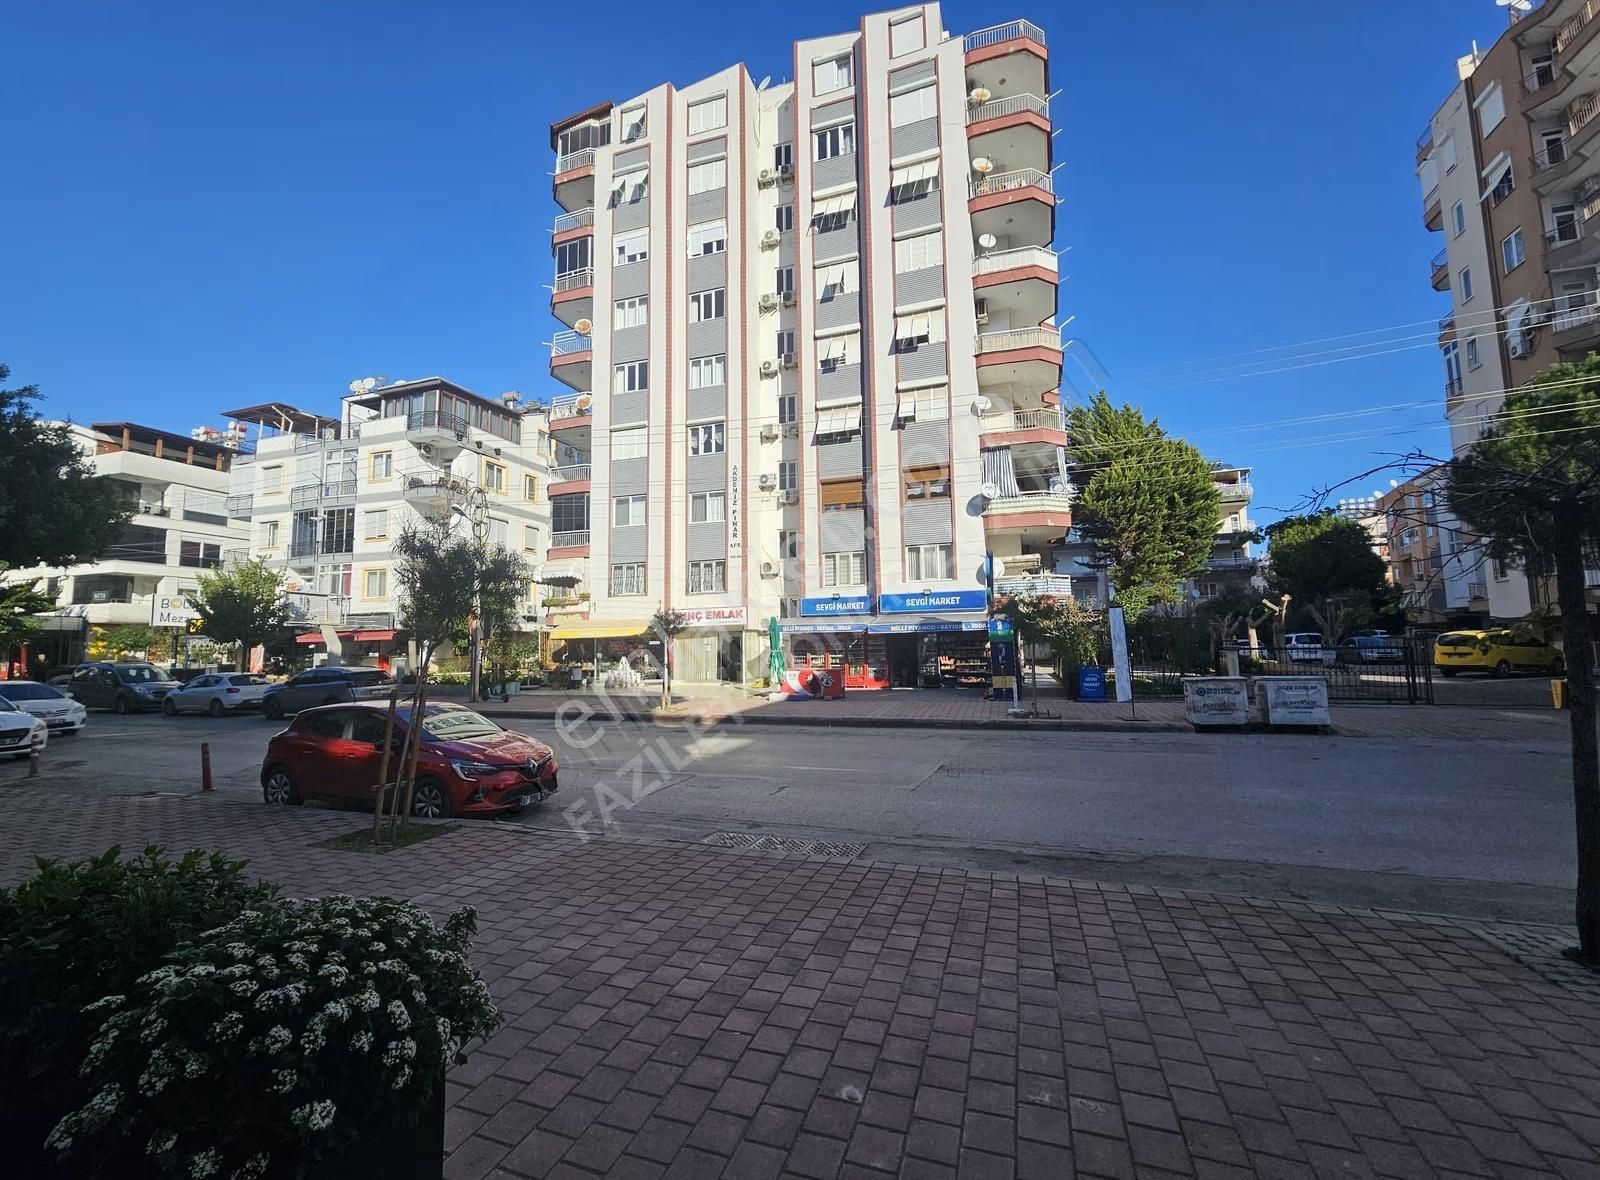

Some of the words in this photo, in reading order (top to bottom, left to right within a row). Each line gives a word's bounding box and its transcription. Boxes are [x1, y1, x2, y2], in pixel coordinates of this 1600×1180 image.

[905, 596, 928, 606] SEVGİ
[929, 596, 961, 605] MARKET
[815, 602, 836, 611] SEVGİ
[836, 602, 865, 610] MARKET
[705, 609, 743, 619] EMLAK
